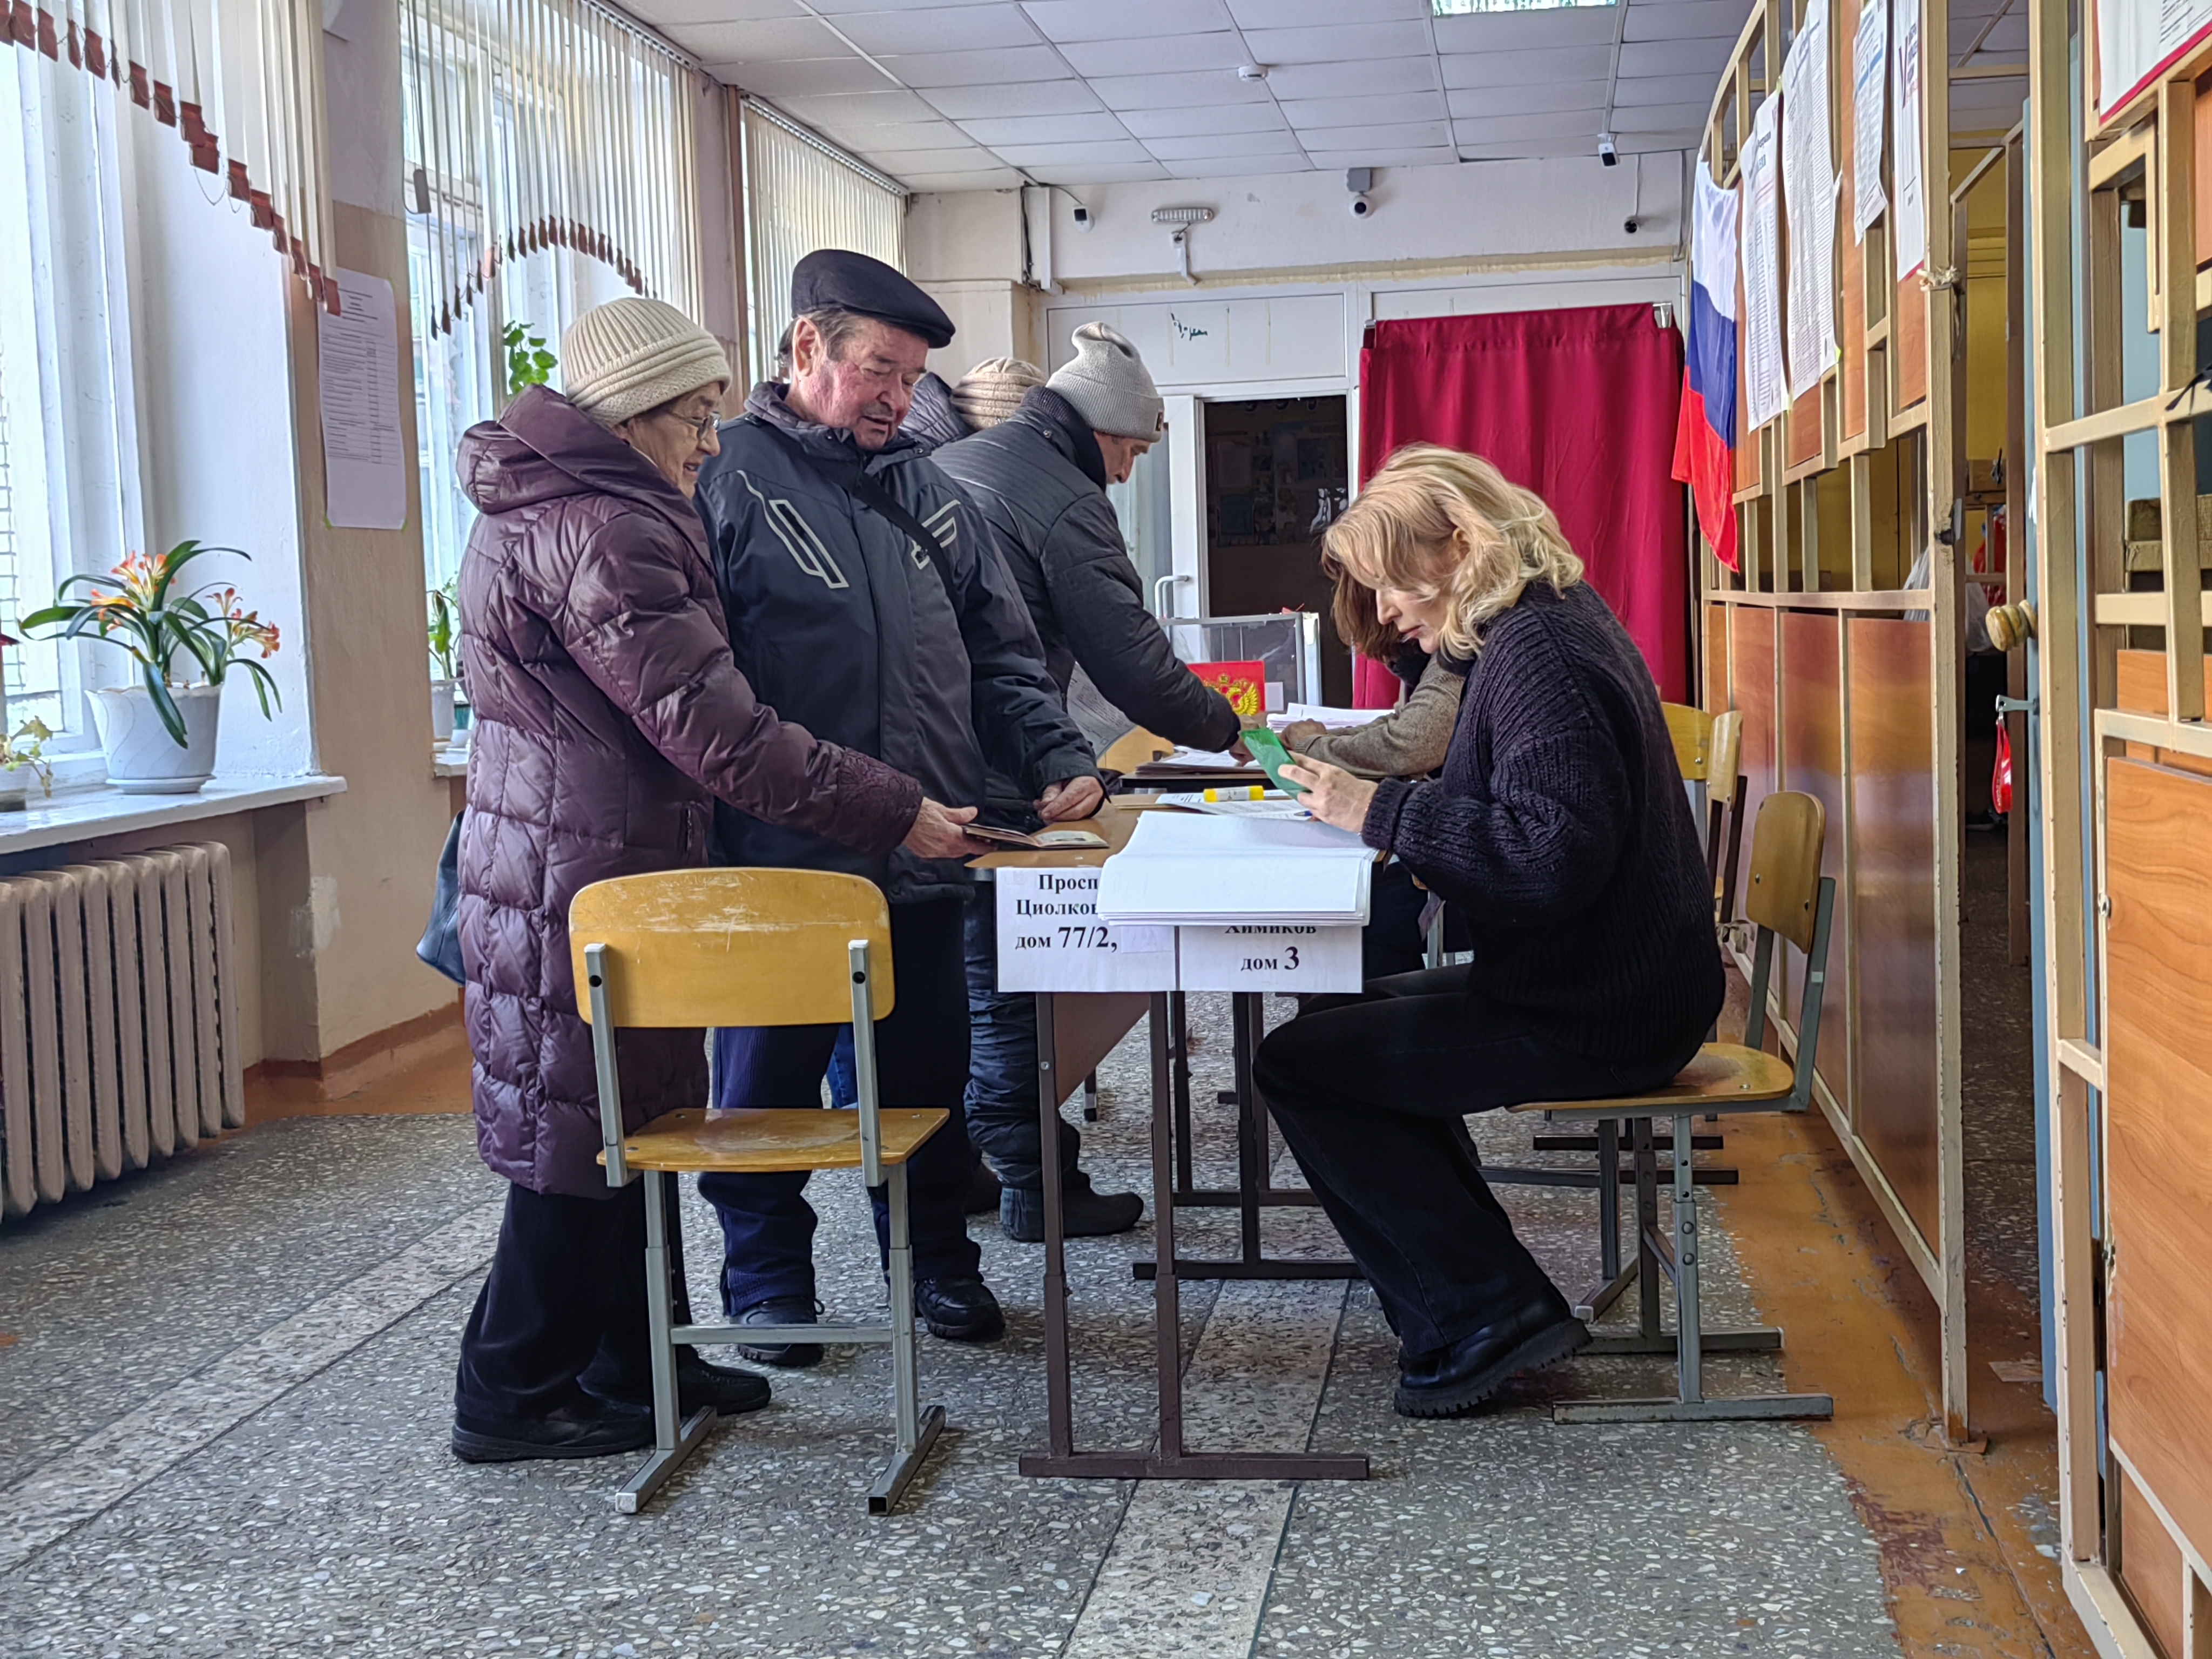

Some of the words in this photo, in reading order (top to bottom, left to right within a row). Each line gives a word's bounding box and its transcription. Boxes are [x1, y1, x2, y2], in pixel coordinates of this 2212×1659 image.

[1015, 936, 1051, 950] дом
[1057, 926, 1117, 953] 77/2,
[1240, 958, 1278, 972] дом
[1284, 946, 1300, 970] 3
